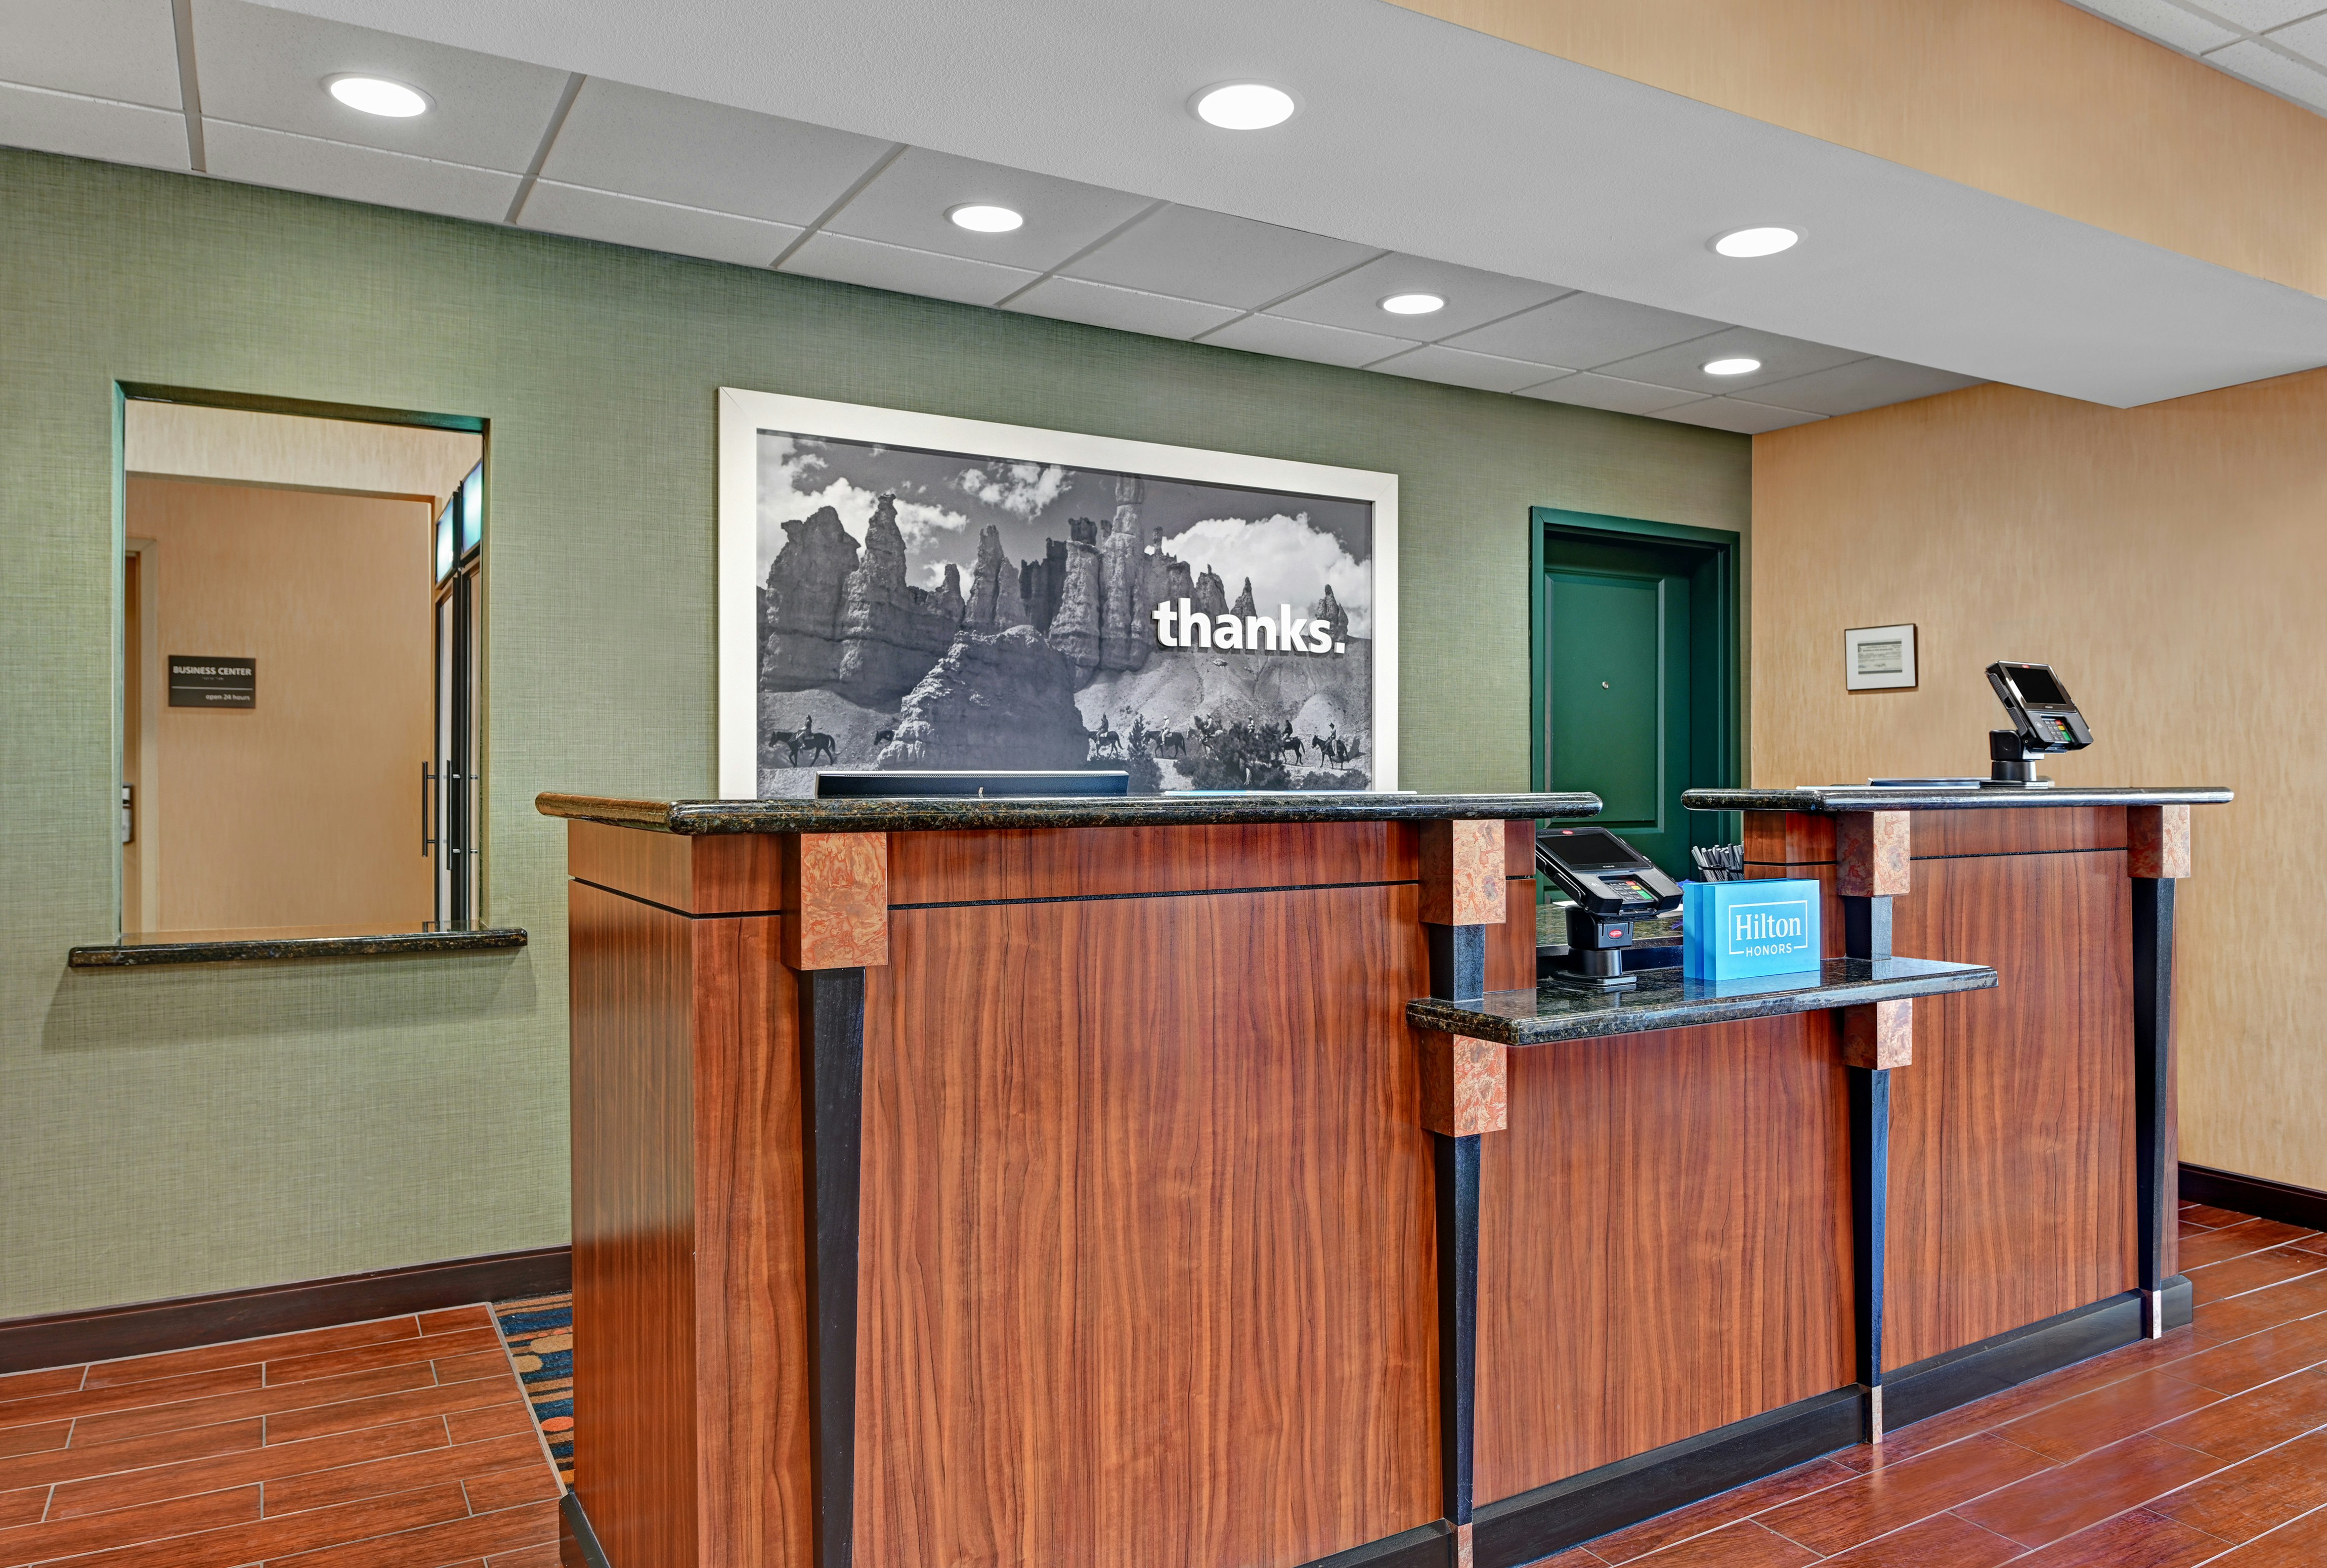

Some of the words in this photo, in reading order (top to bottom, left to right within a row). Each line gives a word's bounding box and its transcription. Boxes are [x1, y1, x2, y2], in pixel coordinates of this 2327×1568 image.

[1152, 597, 1346, 654] thanks.
[173, 666, 217, 675] BUSINESS
[218, 667, 252, 676] CENTER
[1736, 913, 1801, 941] Hilton
[1746, 943, 1792, 957] HONORS
